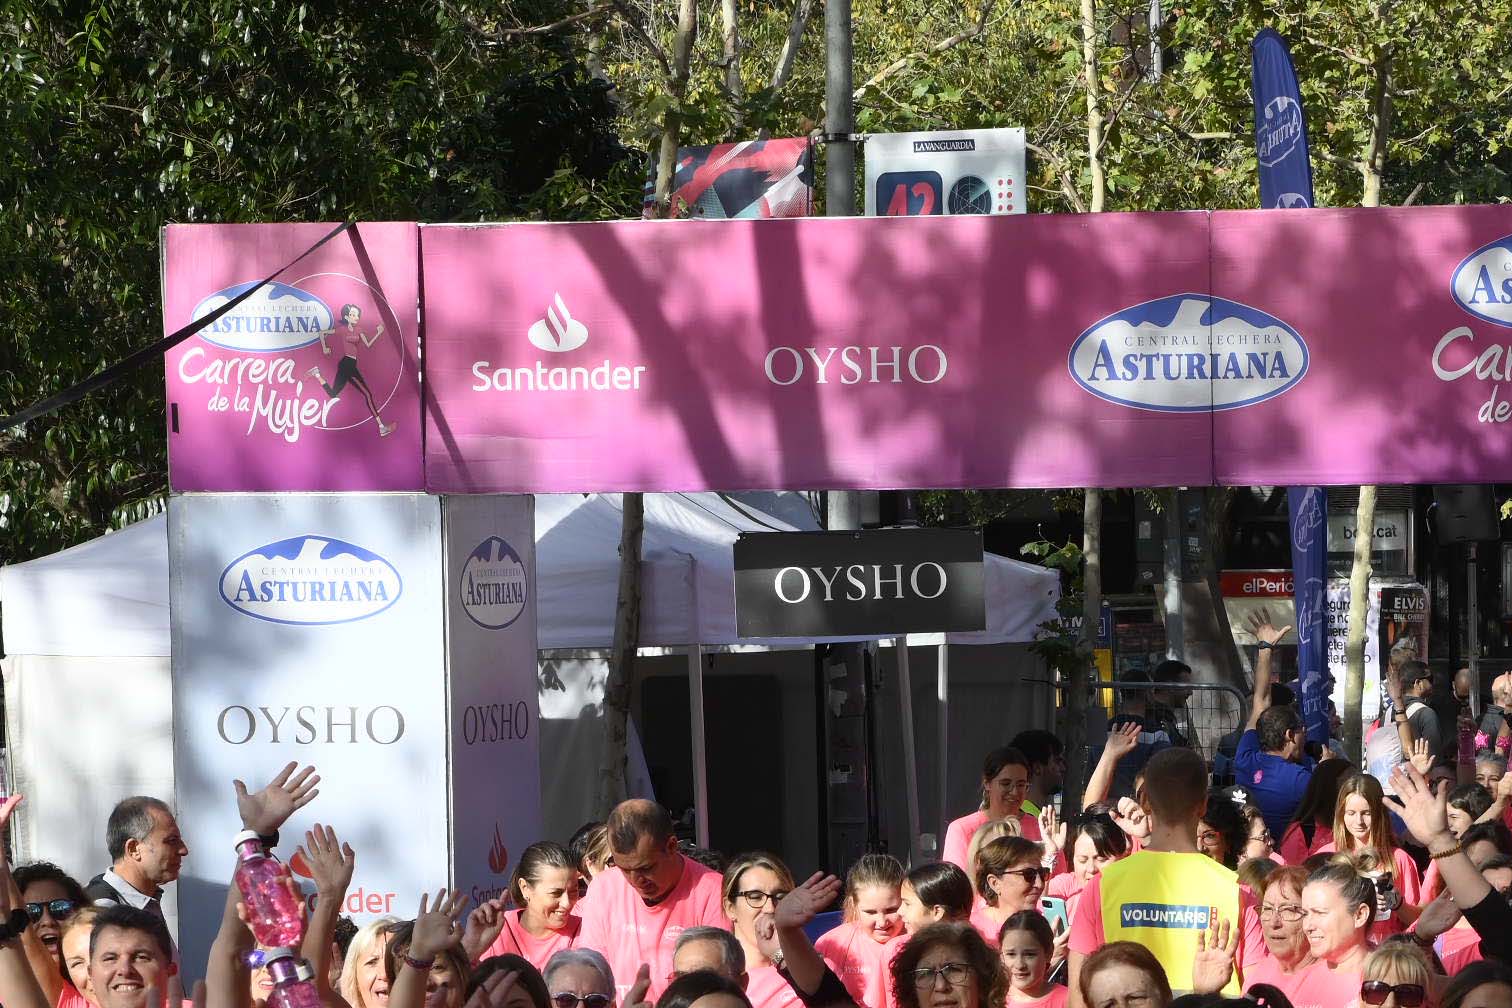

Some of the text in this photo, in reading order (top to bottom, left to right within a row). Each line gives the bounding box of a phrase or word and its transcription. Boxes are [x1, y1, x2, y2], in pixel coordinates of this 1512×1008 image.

[1087, 338, 1291, 381] ASTURIANA
[1124, 333, 1283, 348] CENTRAL LECHERA
[178, 347, 297, 385] Carrera
[471, 359, 646, 393] Santander
[763, 344, 948, 386] OYSHO
[207, 380, 341, 443] de la Mujer
[1477, 383, 1512, 424] de
[234, 568, 389, 602] ASTURIANA
[464, 570, 524, 607] ASTURIANA
[773, 561, 948, 604] OYSHO
[1393, 597, 1425, 611] ELVIS
[216, 704, 406, 745] OYSHO
[463, 701, 530, 746] OYSHO
[1121, 908, 1208, 924] VOLUNTARIS
